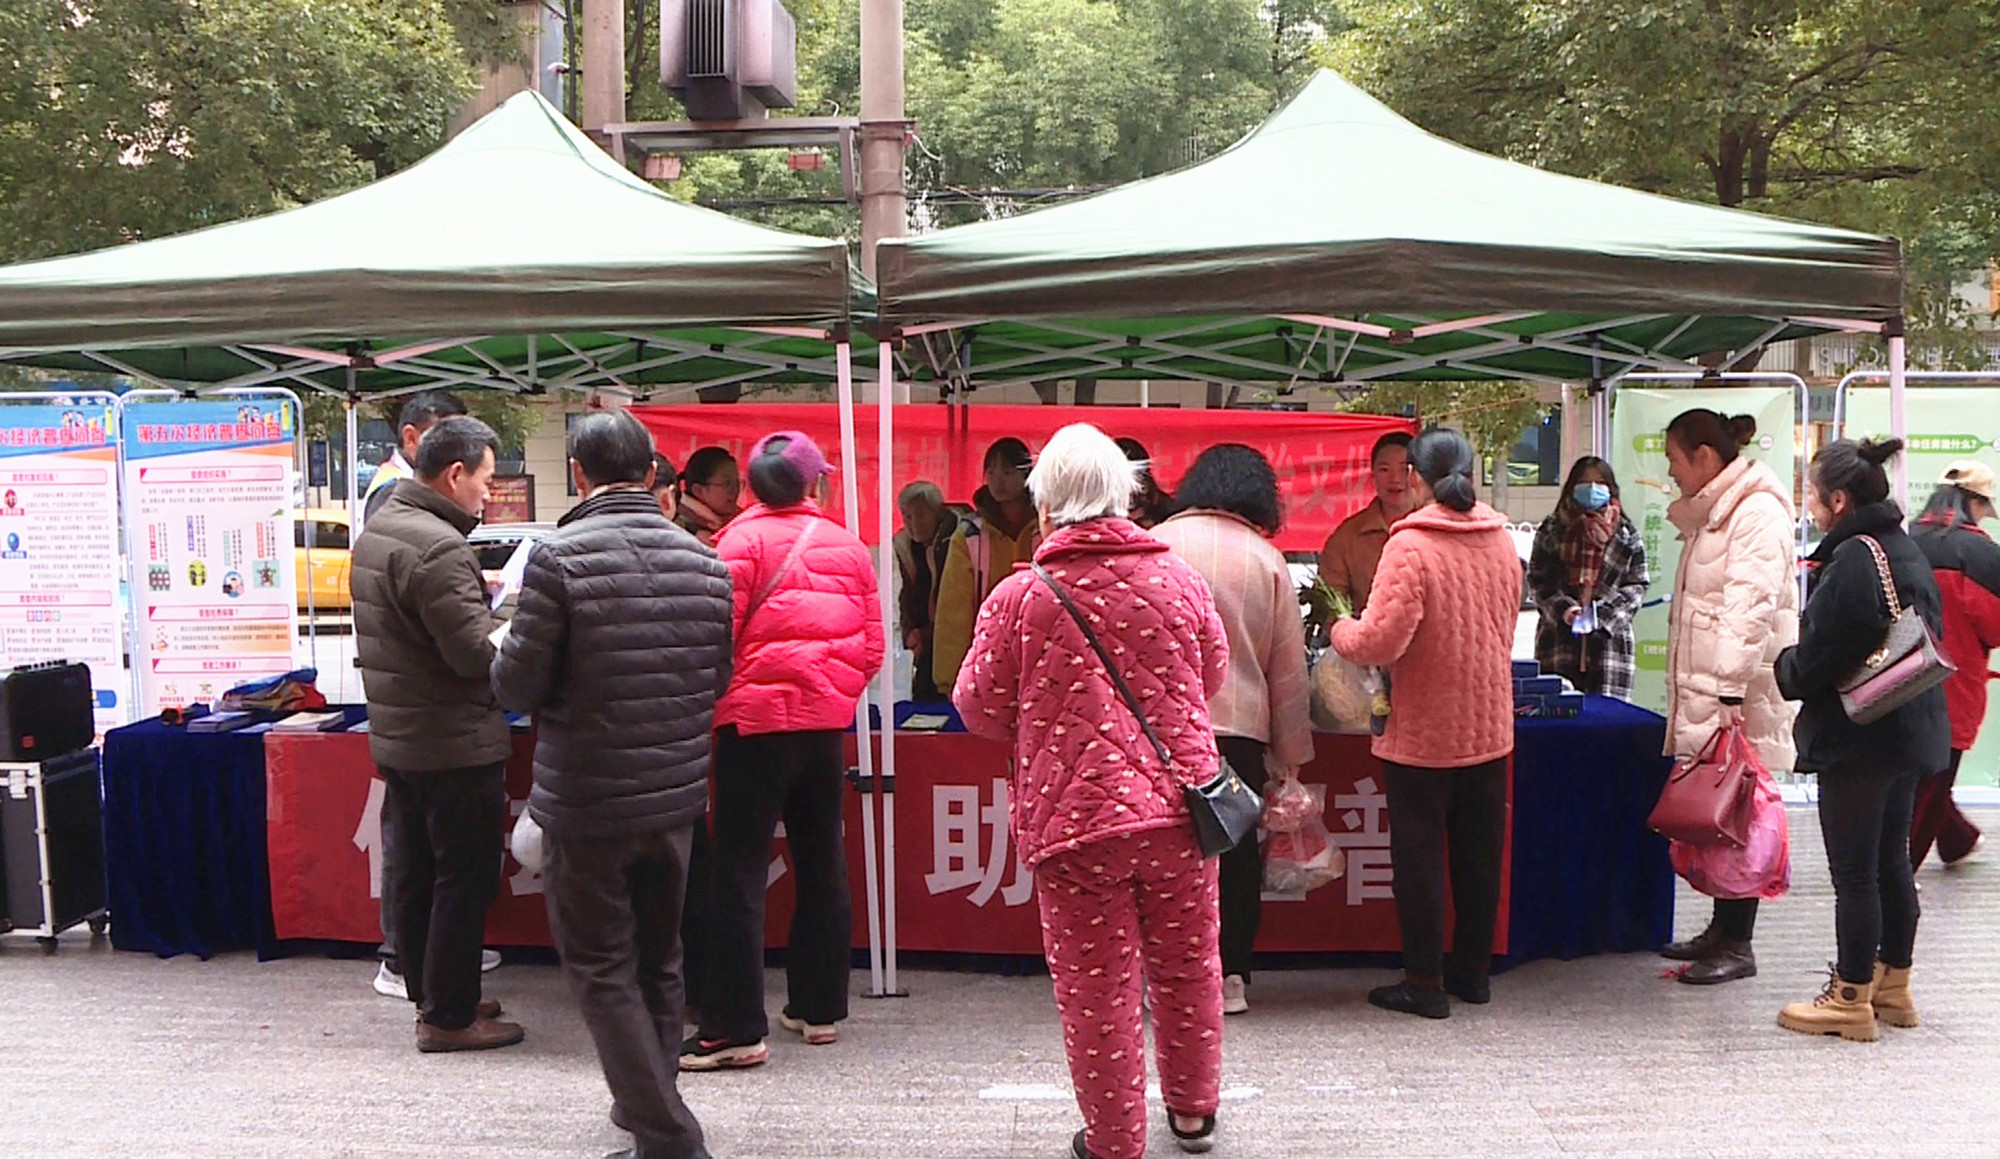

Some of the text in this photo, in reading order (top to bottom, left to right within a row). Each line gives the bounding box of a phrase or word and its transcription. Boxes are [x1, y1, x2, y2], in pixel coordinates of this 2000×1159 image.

[138, 421, 282, 443] 第五次经济普查问答
